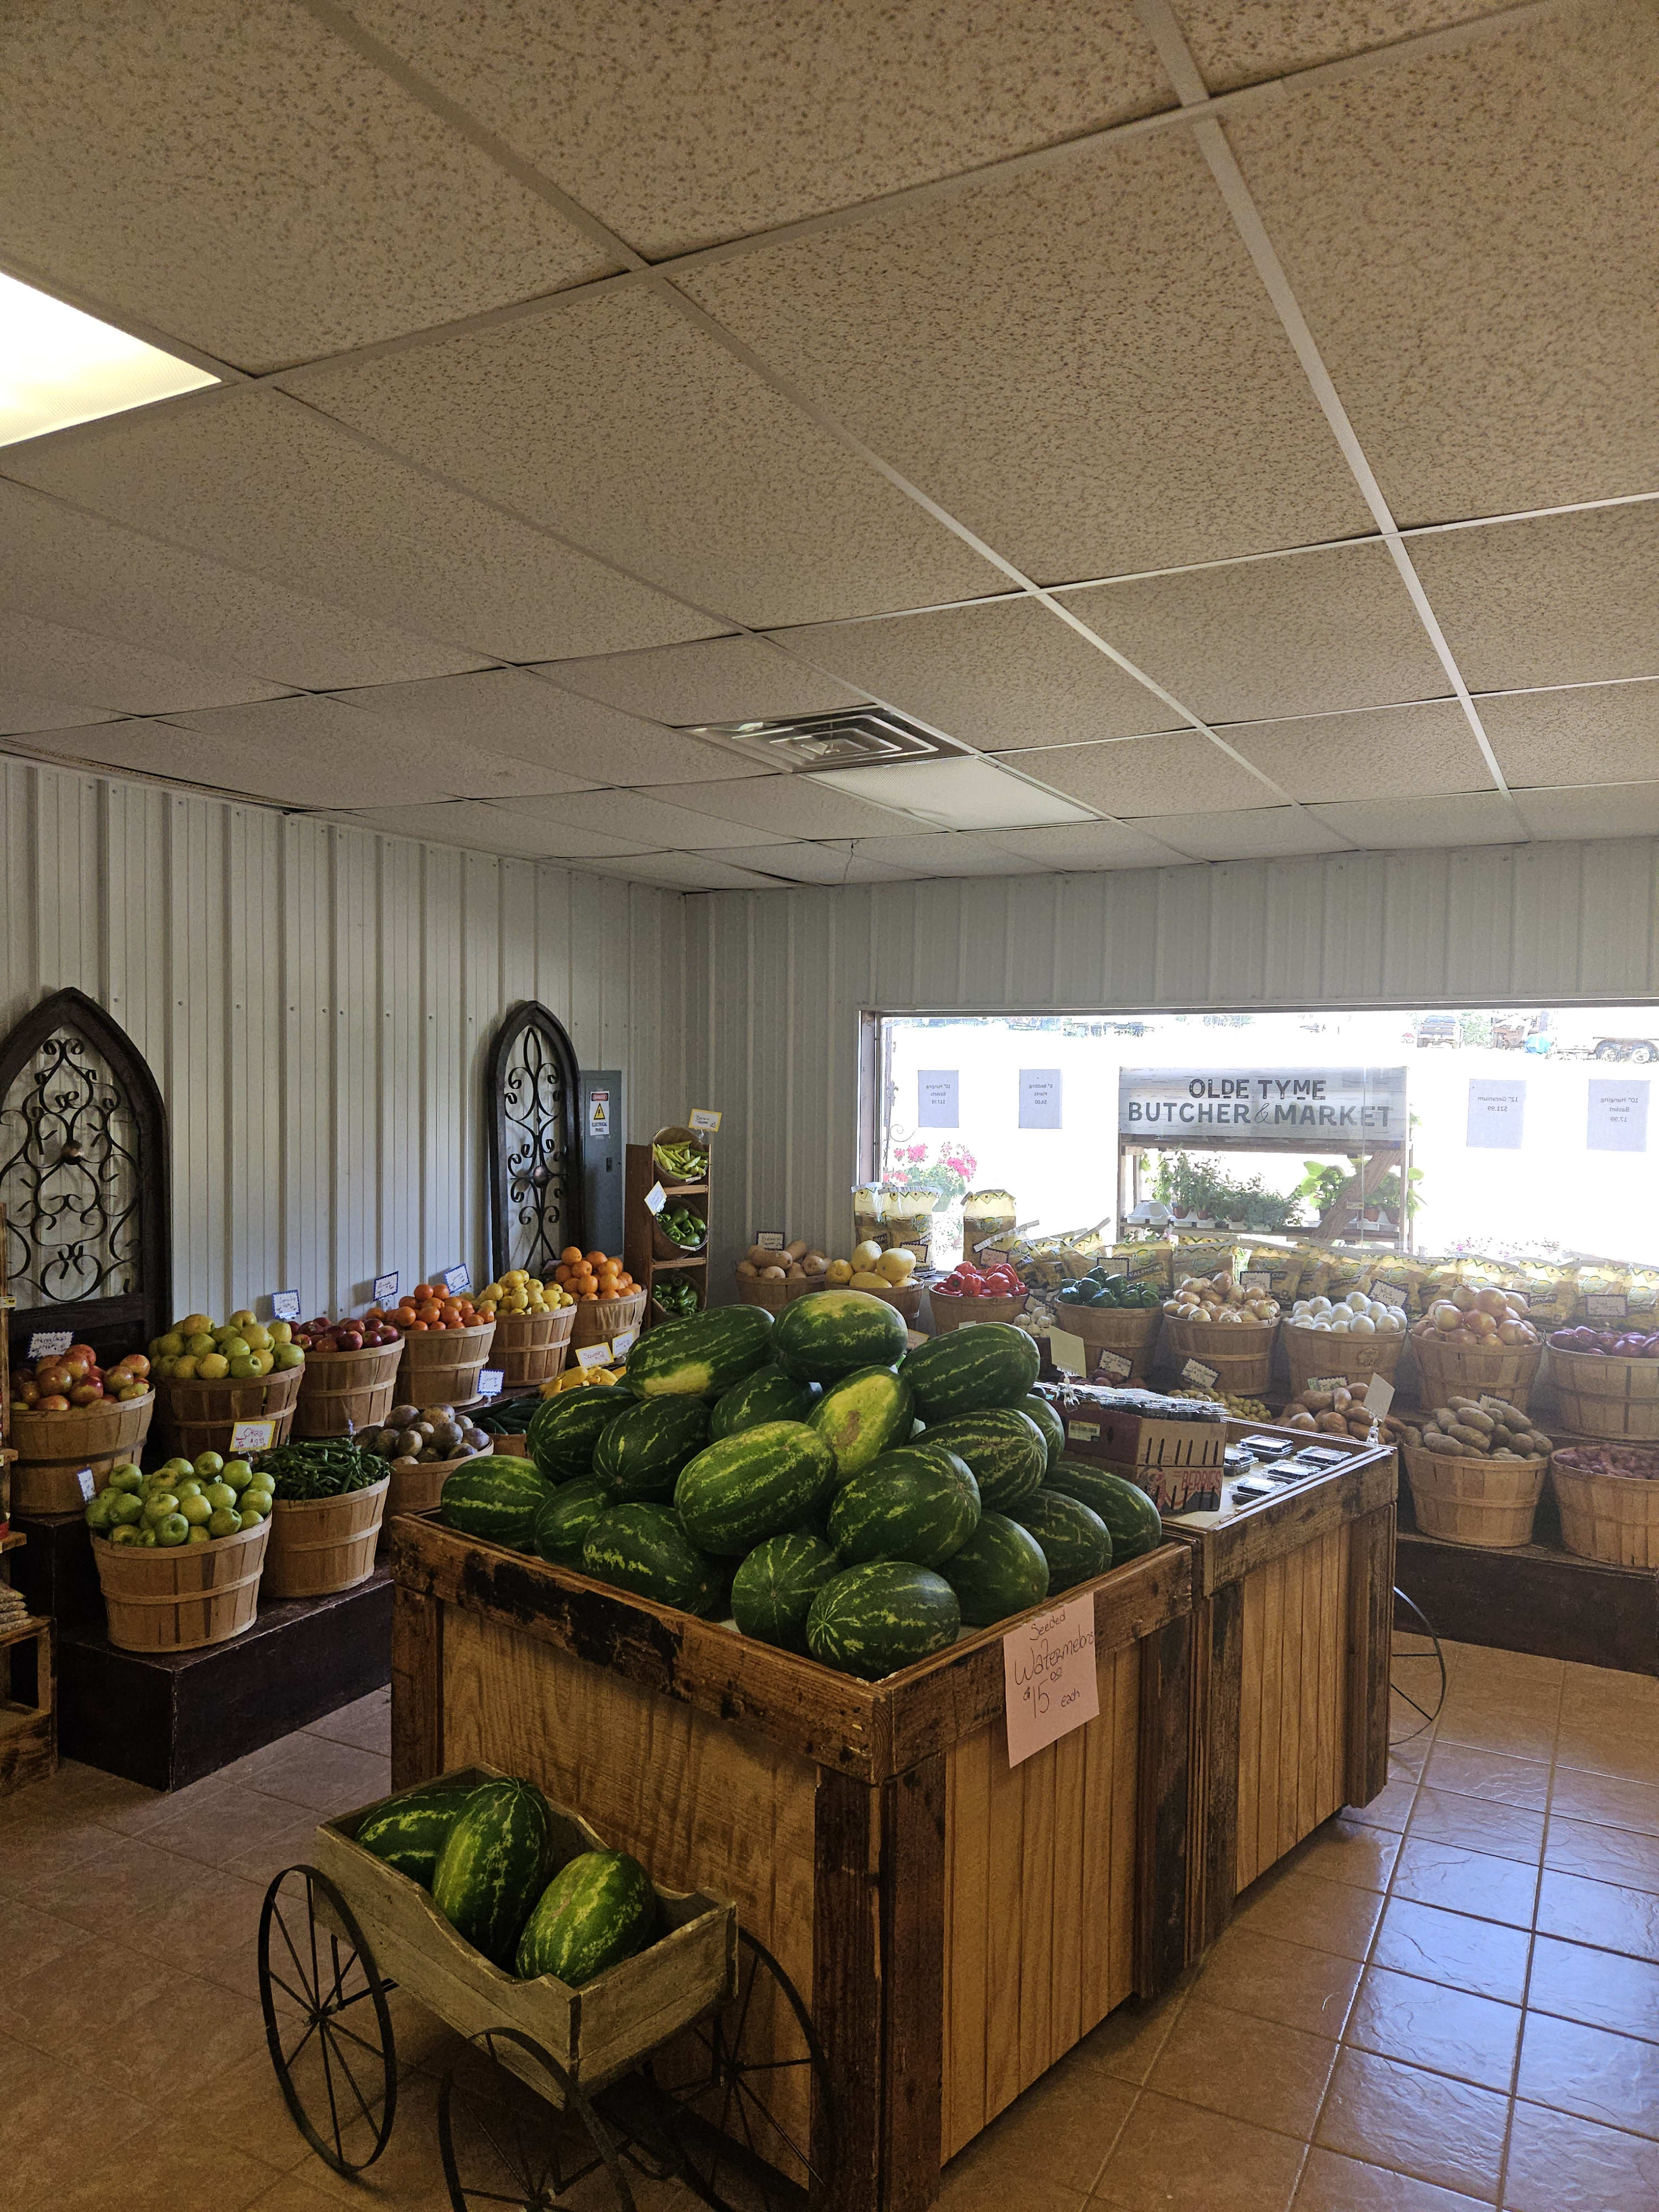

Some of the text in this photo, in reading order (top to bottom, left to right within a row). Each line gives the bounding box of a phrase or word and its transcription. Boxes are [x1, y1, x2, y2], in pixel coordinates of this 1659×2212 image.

[1189, 1078, 1327, 1100] OLDE TYME
[1128, 1102, 1394, 1127] BUTCHER & MARKET
[1128, 1265, 1160, 1277] VALENCIA
[1181, 1470, 1222, 1491] BERRIES
[1030, 1609, 1066, 1641] Seeded
[1061, 1688, 1080, 1708] each
